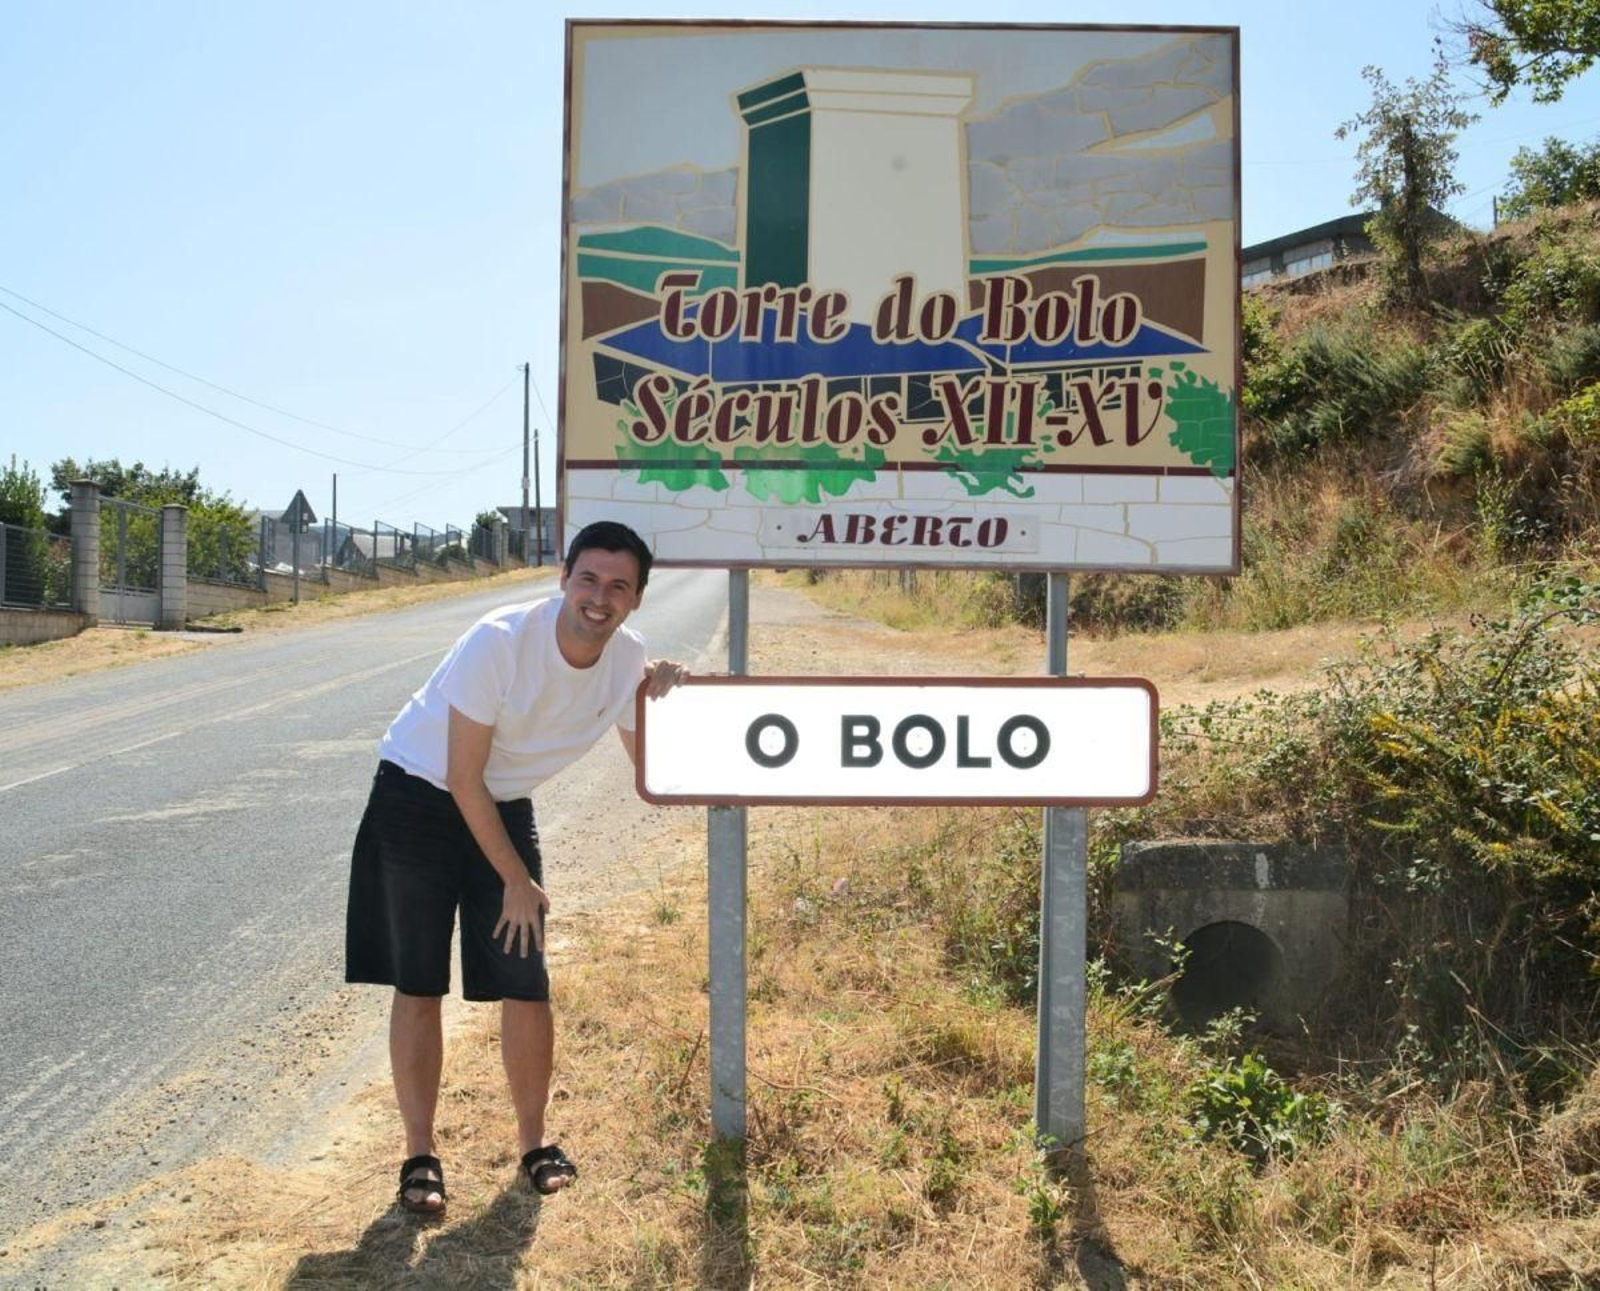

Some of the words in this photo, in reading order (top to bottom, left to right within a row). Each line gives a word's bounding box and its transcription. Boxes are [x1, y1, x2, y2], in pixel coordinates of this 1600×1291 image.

[660, 272, 848, 341] Torre
[875, 275, 957, 342] do
[980, 275, 1139, 343] Bolo
[631, 375, 899, 446] Séculos
[922, 378, 1164, 448] XII-XV
[796, 512, 1009, 548] ABERTO
[745, 713, 799, 769] O
[841, 714, 1051, 769] BOLO
